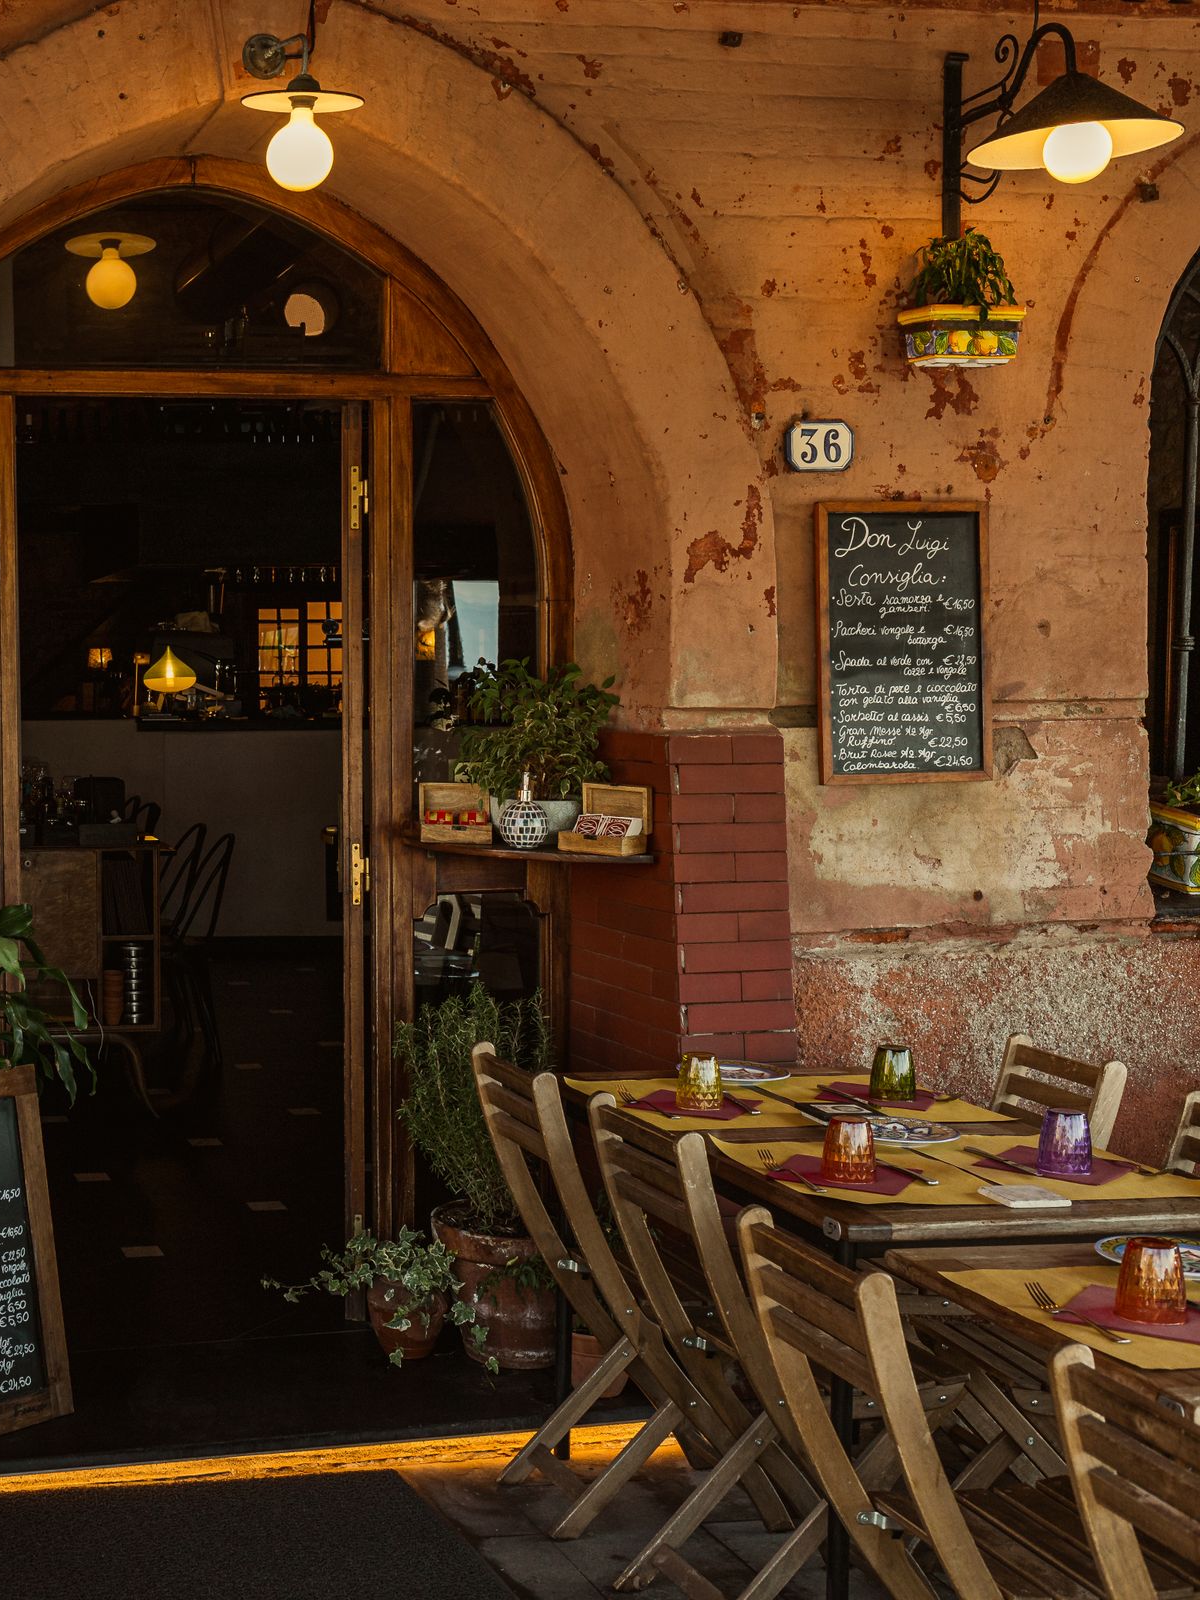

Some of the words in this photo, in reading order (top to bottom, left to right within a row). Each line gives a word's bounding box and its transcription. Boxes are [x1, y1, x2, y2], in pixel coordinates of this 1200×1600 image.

[800, 428, 841, 464] 36
[835, 517, 896, 558] Don
[898, 520, 950, 559] Luigi
[834, 620, 876, 638] Paccheri
[835, 650, 873, 671] Spada
[876, 657, 887, 666] al
[917, 658, 933, 666] con
[836, 683, 870, 696] Torta
[874, 684, 886, 695] di
[888, 684, 910, 696] pere
[926, 683, 978, 693] cioccolato
[839, 697, 858, 707] con
[862, 695, 894, 708] gelato
[898, 695, 918, 705] alla
[922, 694, 959, 707] vaniglia
[837, 709, 885, 723] Sorbetto
[887, 712, 899, 722] al
[838, 725, 867, 744] Gran
